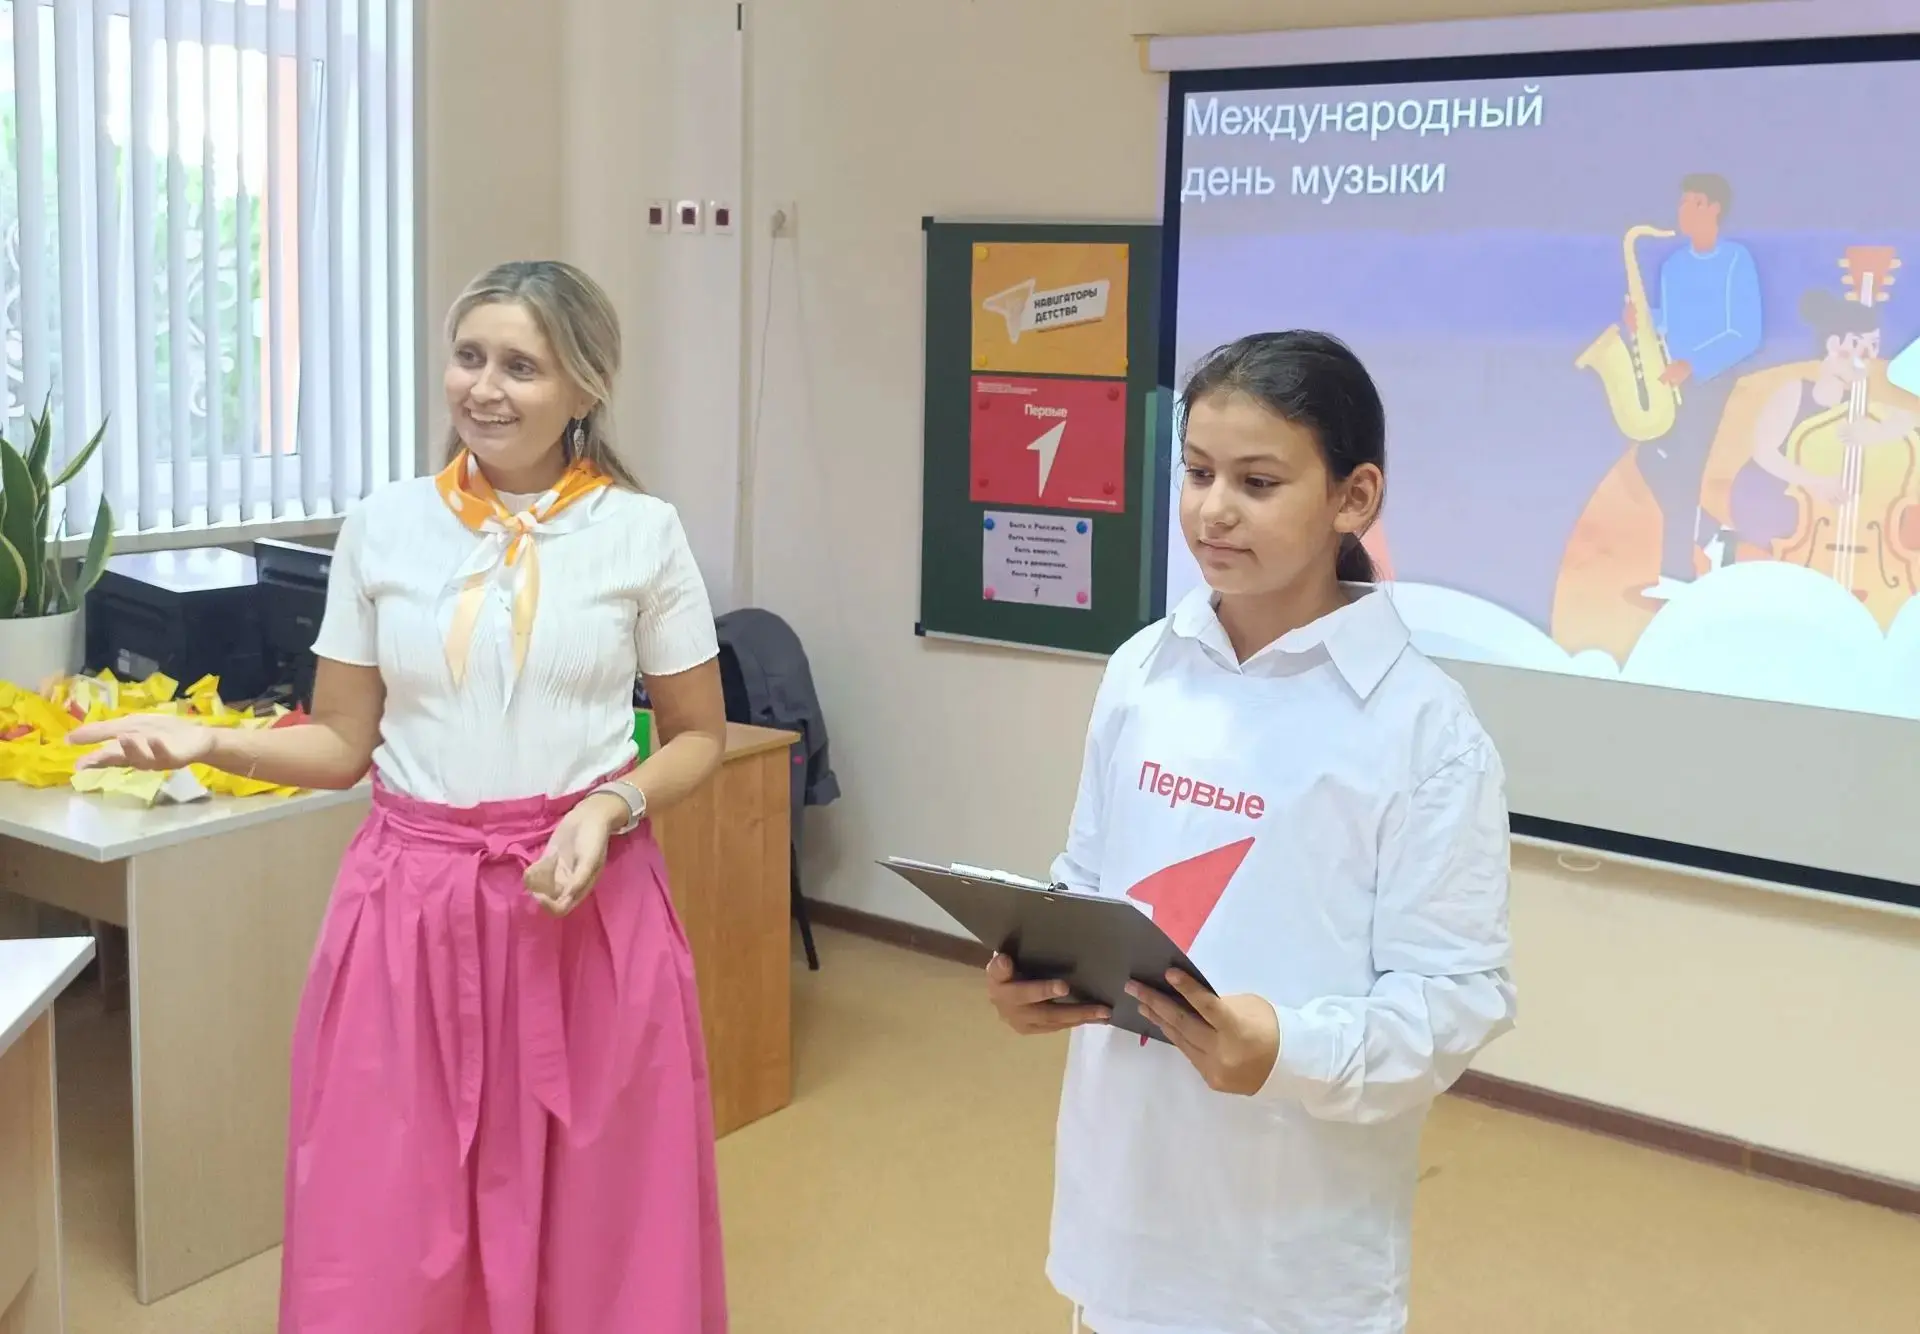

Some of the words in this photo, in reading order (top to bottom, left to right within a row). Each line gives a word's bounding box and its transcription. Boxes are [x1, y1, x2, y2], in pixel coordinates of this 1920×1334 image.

[1185, 84, 1543, 143] Международный
[1180, 164, 1276, 203] день
[1291, 163, 1446, 204] музыки
[1034, 288, 1098, 309] НАВИГАТОРЫ
[1035, 305, 1078, 324] ДЕТСТВА
[1024, 403, 1068, 420] Первые
[1138, 761, 1265, 819] Первые
